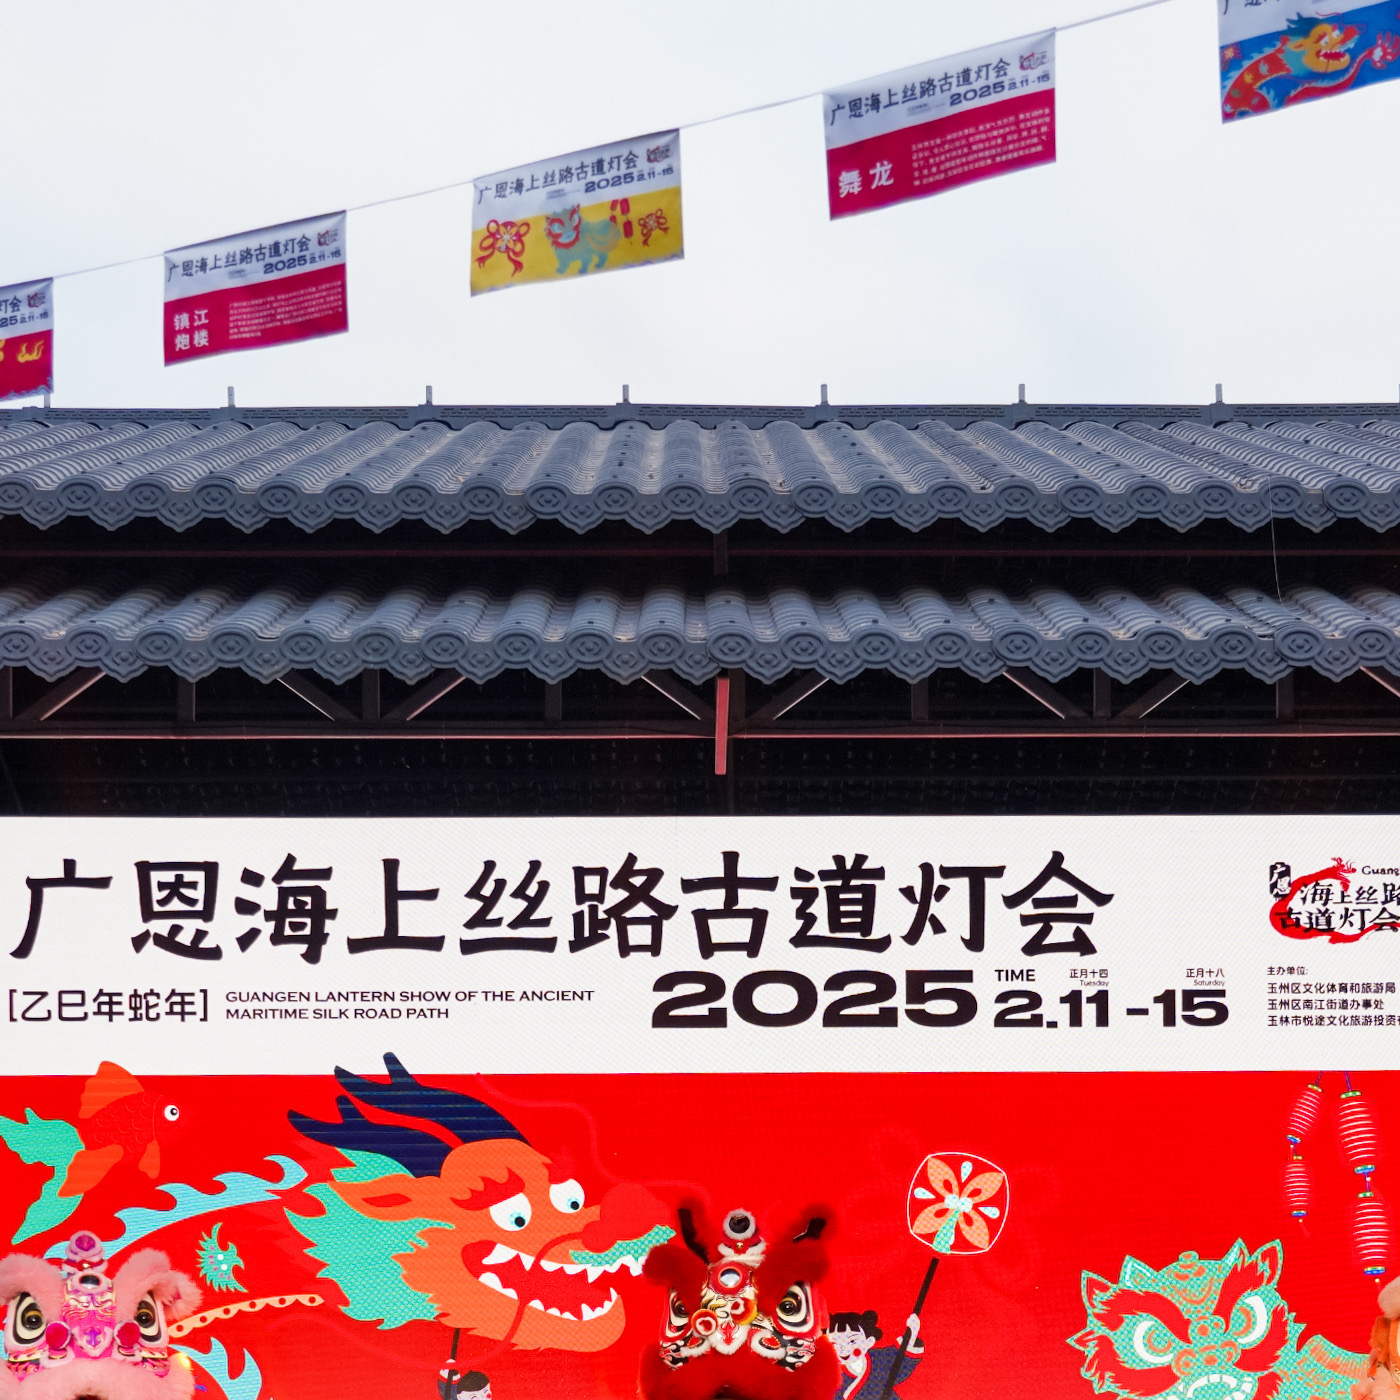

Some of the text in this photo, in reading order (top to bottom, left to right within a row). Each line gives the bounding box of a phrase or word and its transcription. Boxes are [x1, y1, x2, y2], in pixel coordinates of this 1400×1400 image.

[830, 58, 1011, 126] 广恩海上丝路古道灯会
[950, 81, 1005, 107] 2025
[478, 150, 639, 204] 广恩海上丝路古道灯会
[585, 175, 635, 193] 2025
[839, 160, 894, 198] 舞龙
[168, 234, 311, 282] 广恩海上丝路古道灯会
[263, 255, 308, 275] 2025
[10, 851, 1115, 964] 广恩海上丝路古道灯会
[995, 969, 1035, 981] TIME
[1070, 969, 1108, 978] 正月十四
[1186, 968, 1225, 978] 正月十八
[1080, 979, 1109, 987] Tuesday
[1267, 982, 1396, 994] 玉州区文化体育和旅游局
[226, 990, 594, 1002] GUANGEN LANTERN SHOW OF THE ANCIENT
[652, 970, 978, 1028] 2025
[1267, 999, 1384, 1011] 玉州区南江街道办事处
[226, 1008, 449, 1019] MARITIME SILK ROAD PATH
